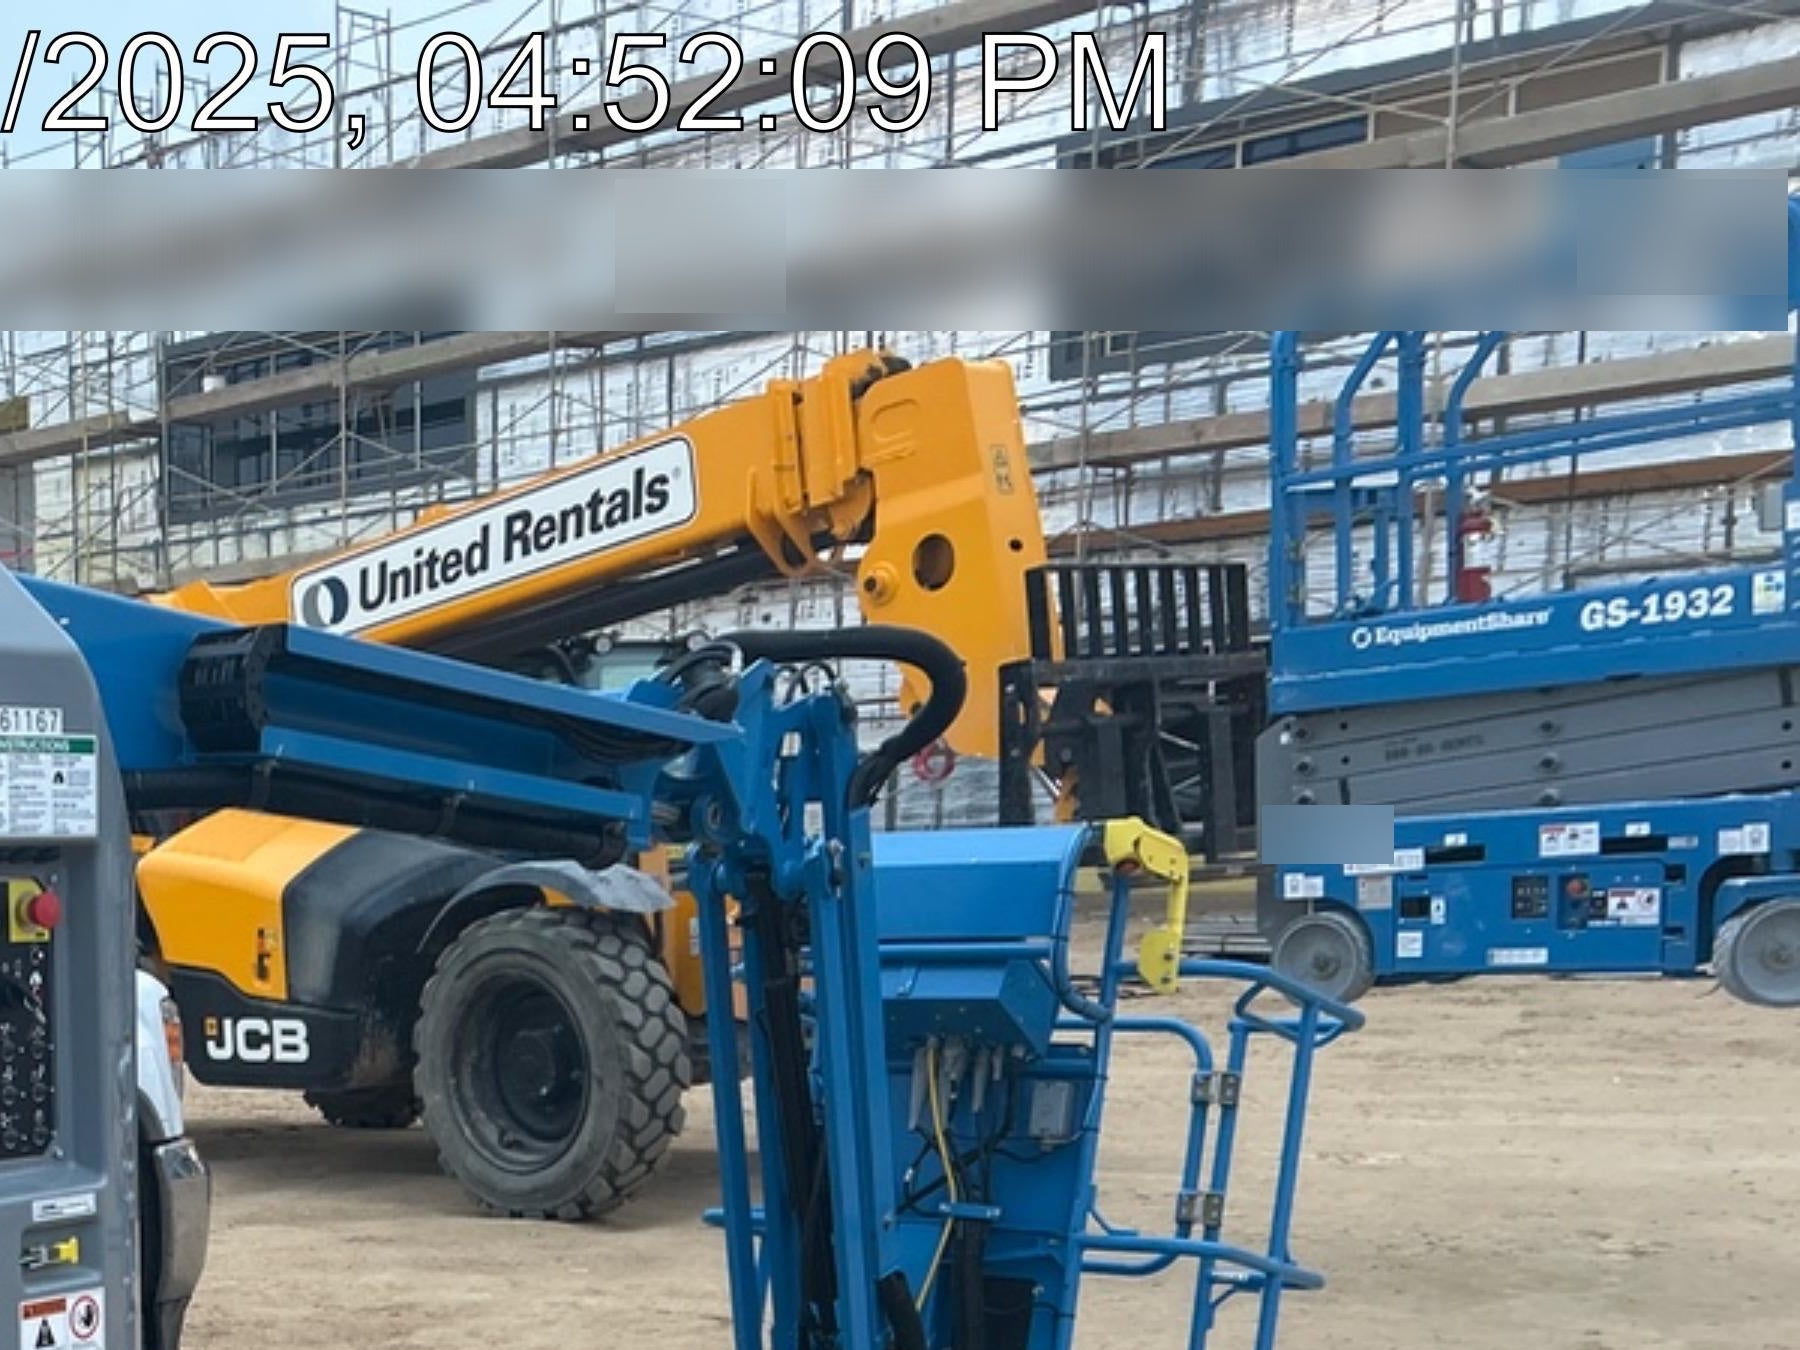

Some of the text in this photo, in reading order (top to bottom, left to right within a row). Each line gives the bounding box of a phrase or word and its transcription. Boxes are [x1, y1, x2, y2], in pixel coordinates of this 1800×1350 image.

[358, 467, 671, 612] United Rentals
[1375, 583, 1736, 648] EquipmentShare GS-1932
[205, 1016, 310, 1063] JCB
